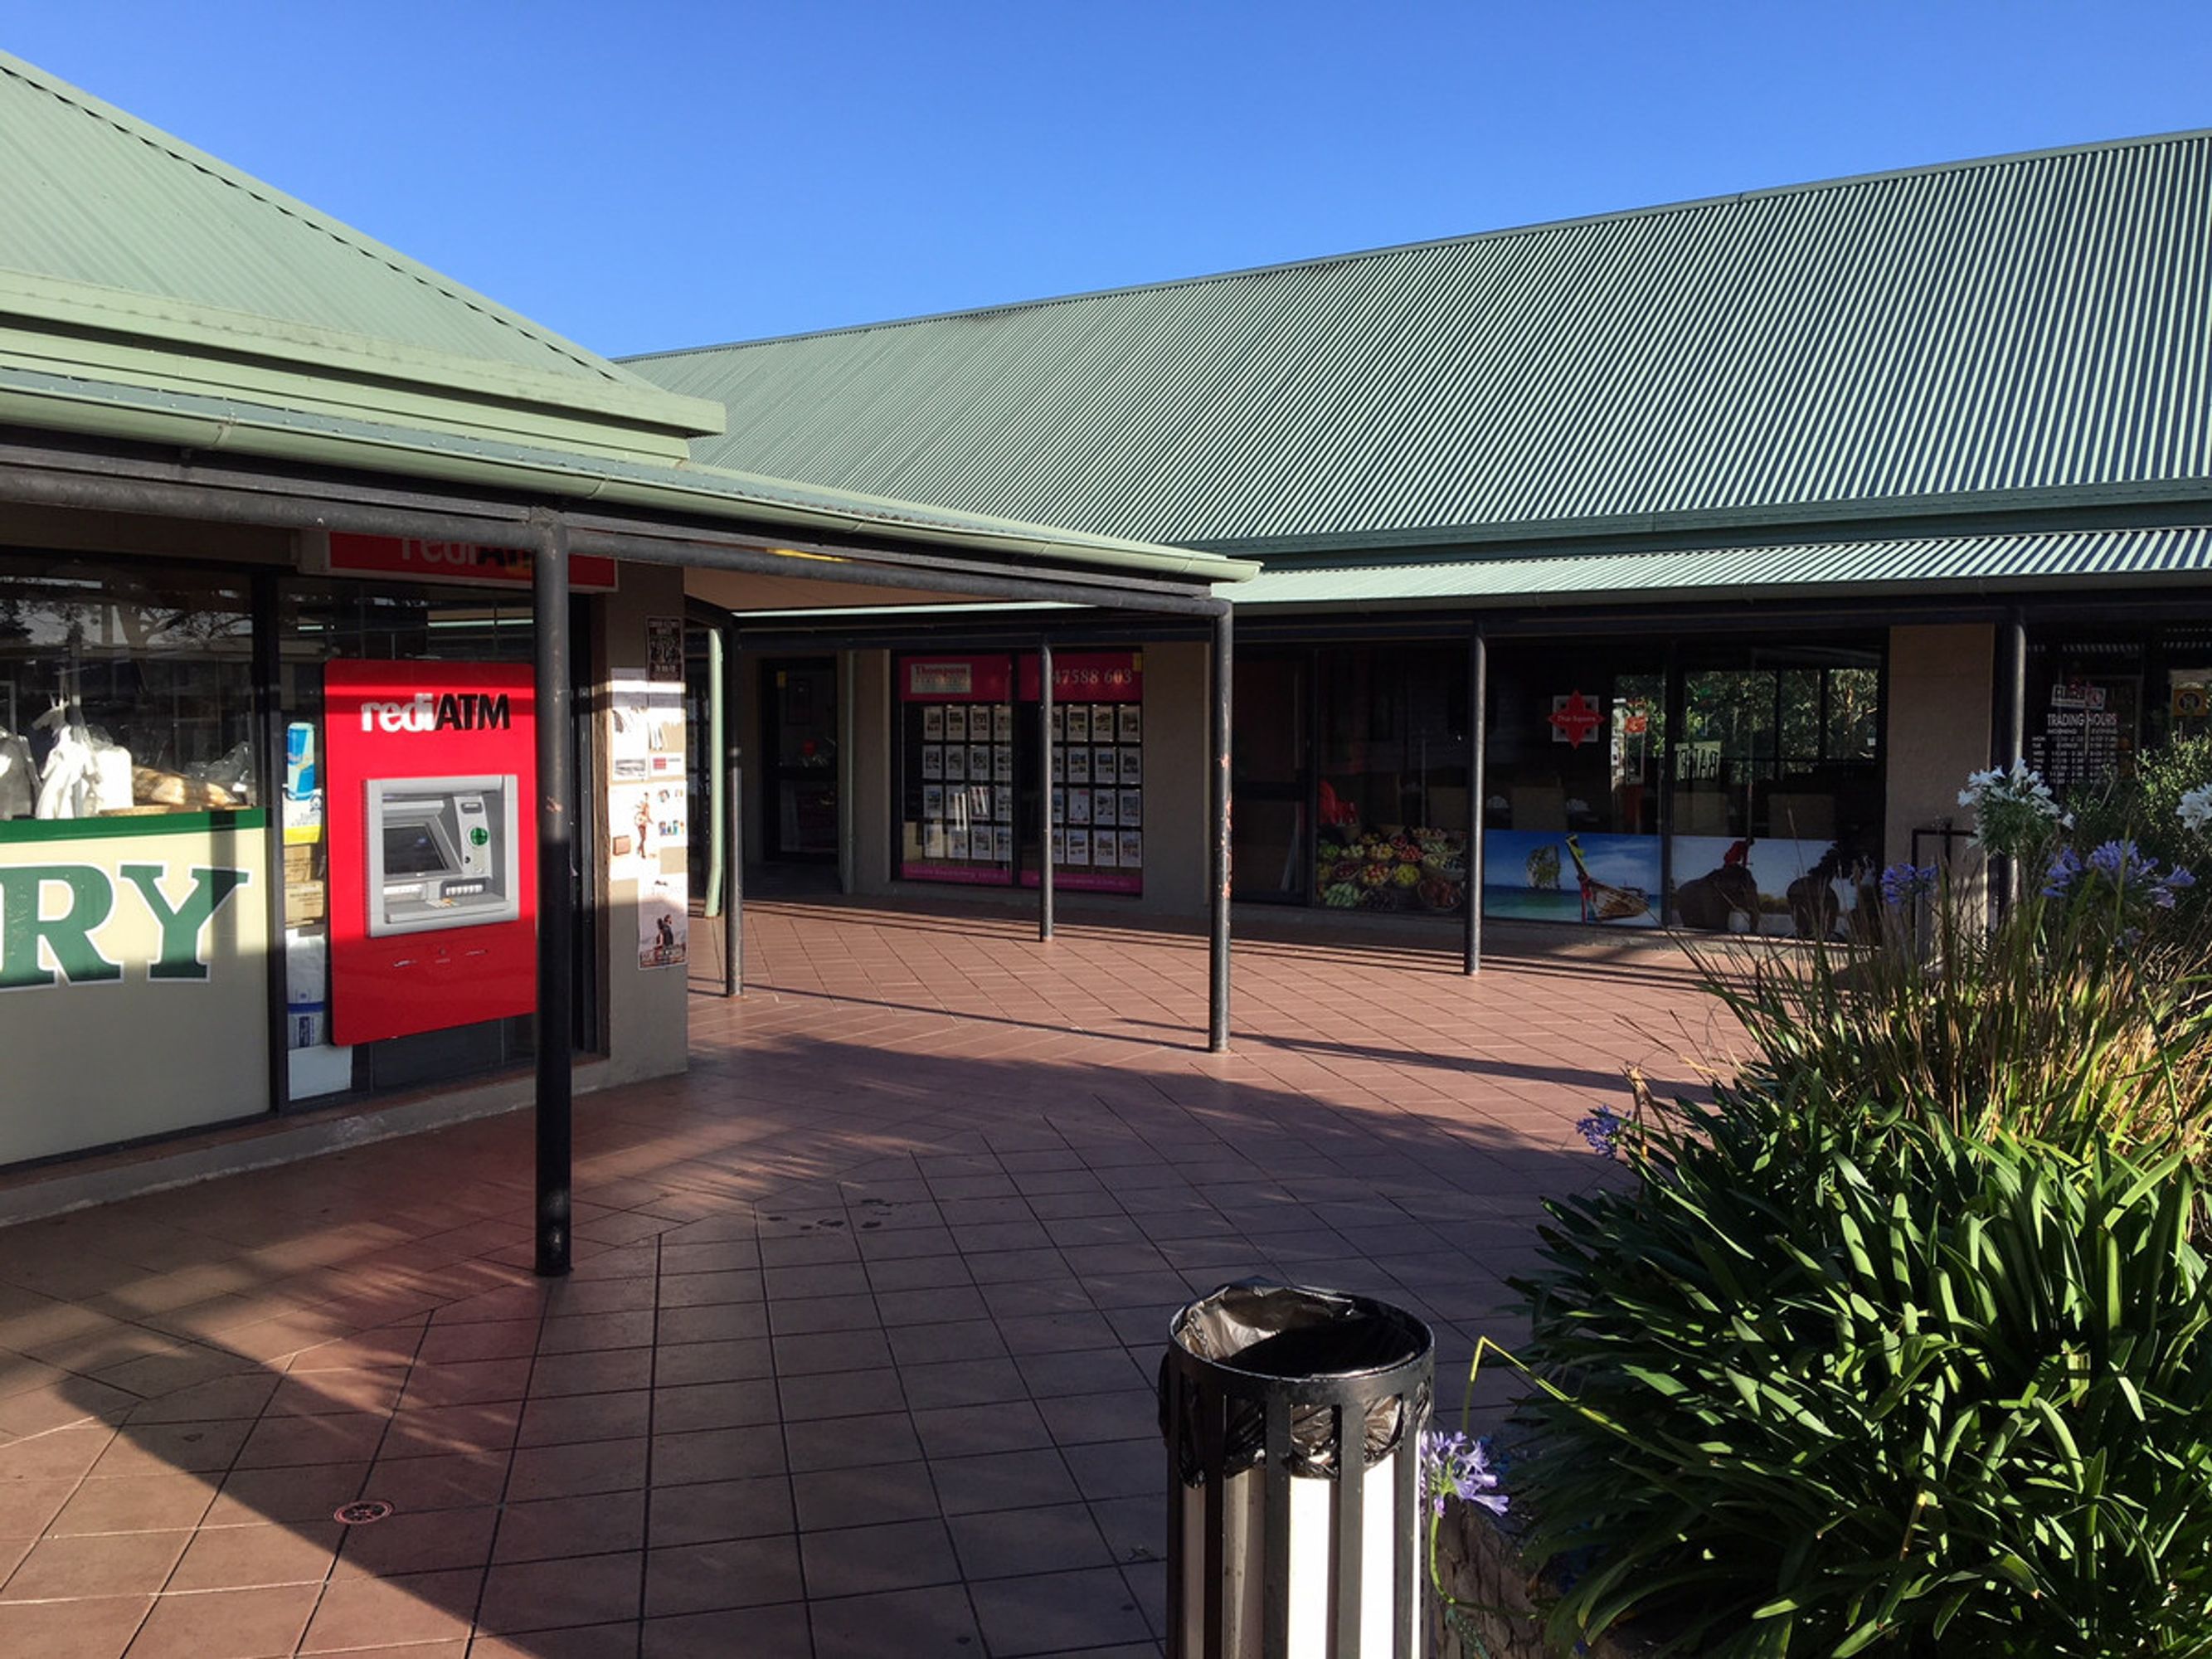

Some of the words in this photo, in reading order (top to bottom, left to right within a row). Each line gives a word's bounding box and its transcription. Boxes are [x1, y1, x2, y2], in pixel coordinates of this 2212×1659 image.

[1104, 669, 1133, 684] 603
[361, 693, 511, 733] rediATM
[2047, 713, 2085, 727] TRADING
[0, 863, 248, 988] RY
